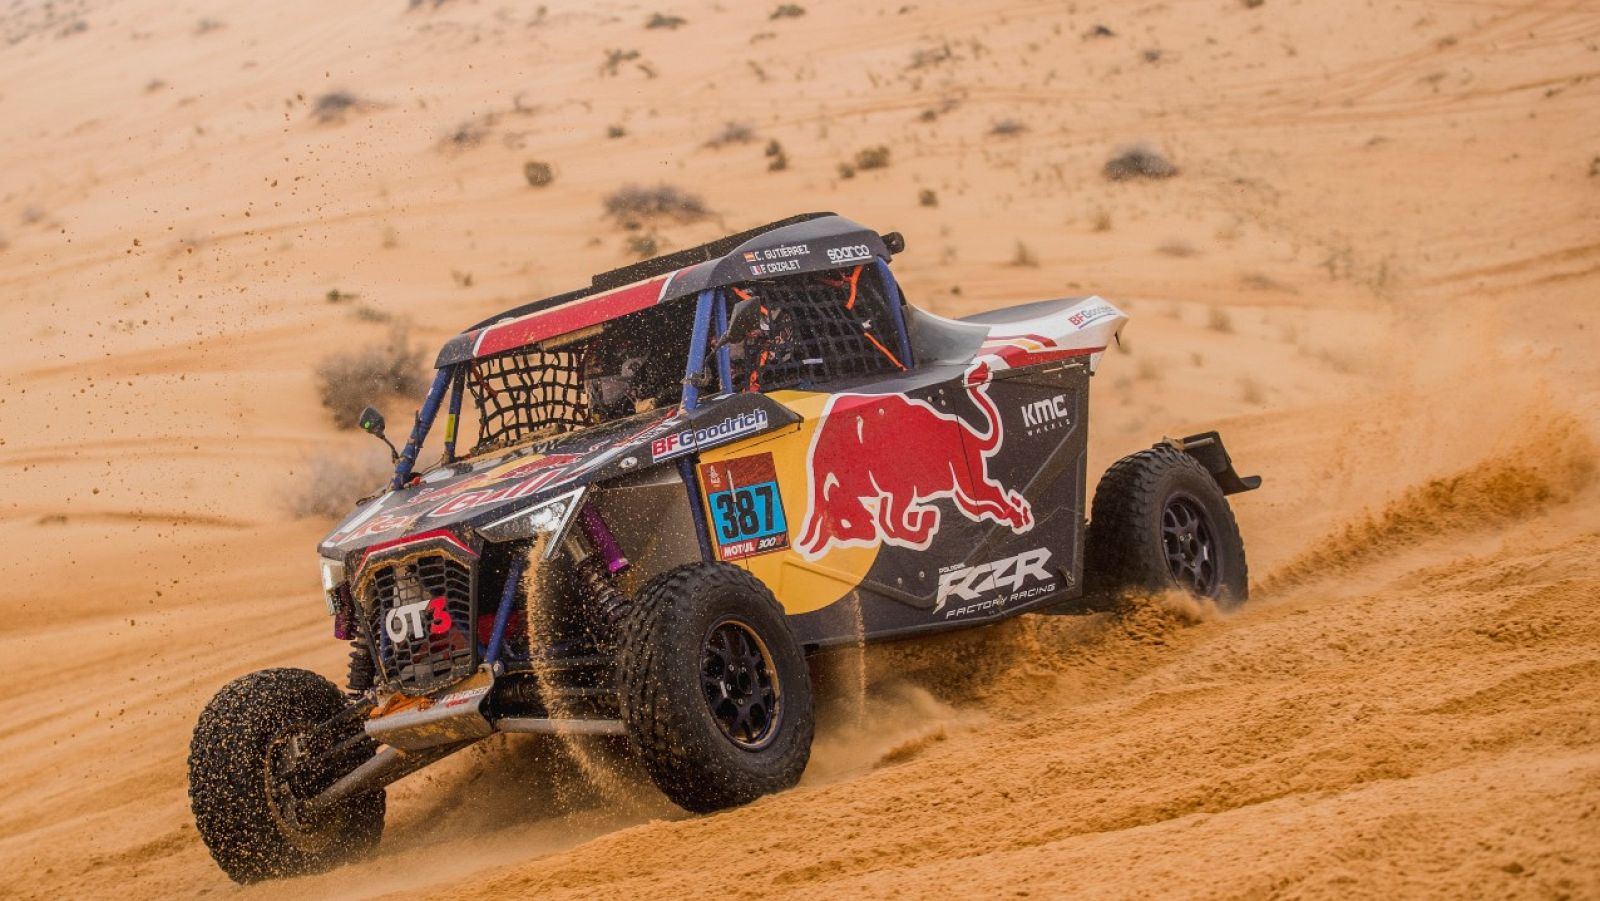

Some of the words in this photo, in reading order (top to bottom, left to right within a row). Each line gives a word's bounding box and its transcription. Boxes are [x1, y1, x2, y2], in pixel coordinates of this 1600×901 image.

[826, 244, 871, 261] sparco
[651, 408, 768, 457] BFGoodrich
[716, 485, 774, 539] 387
[724, 541, 755, 557] MOTUL
[385, 595, 453, 643] OT3
[945, 594, 1008, 620] FACTORY
[1010, 583, 1057, 602] RACING
